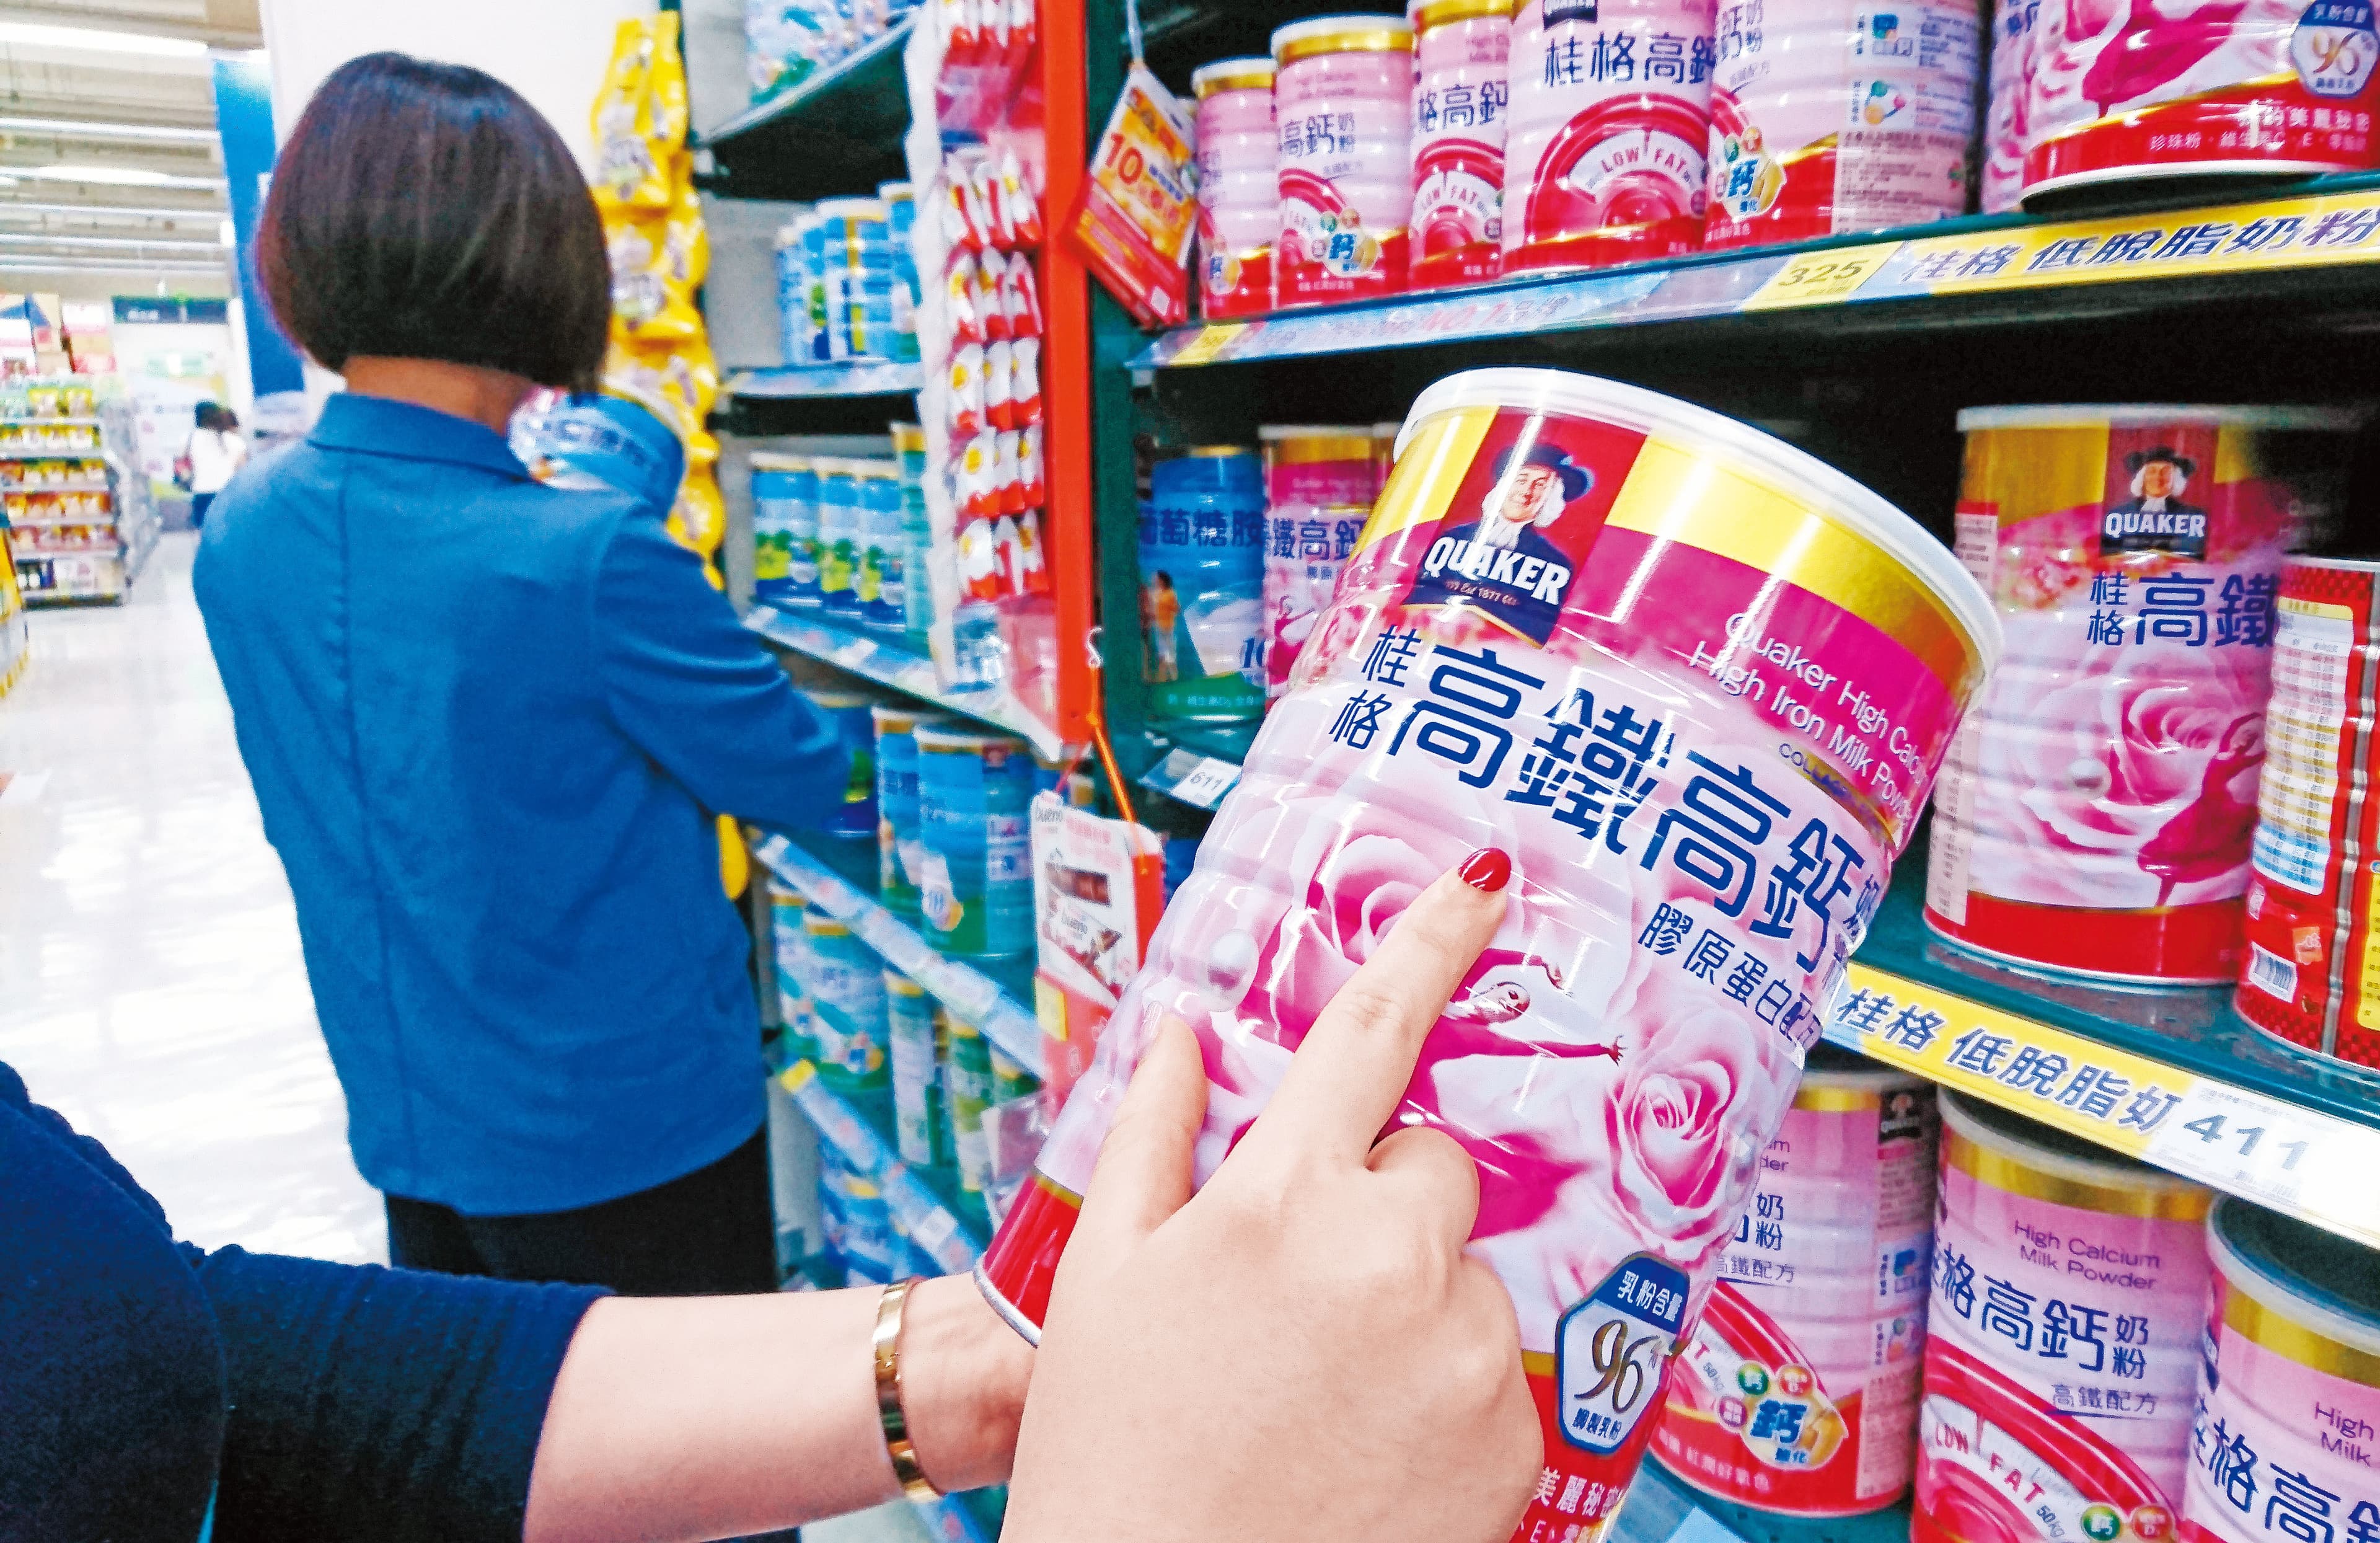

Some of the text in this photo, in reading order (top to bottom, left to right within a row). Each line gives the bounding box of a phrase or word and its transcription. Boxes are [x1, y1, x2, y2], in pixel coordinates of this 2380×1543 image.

[1779, 259, 1869, 286] 325
[1900, 244, 2024, 279] 桂格
[2105, 512, 2205, 537] QUAKER
[1424, 536, 1571, 606] QUAKER
[2086, 571, 2130, 647] 桂格
[1725, 612, 1838, 692] Quaker
[1836, 680, 1889, 739] High
[1688, 640, 1766, 702] High
[1770, 685, 1826, 740] Iron
[1828, 725, 1874, 777] Milk
[1189, 771, 1223, 792] 611
[1329, 624, 1423, 750] 桂格
[1386, 648, 1866, 974] 高鐵高鈣
[1836, 988, 1946, 1051] 桂格
[2183, 1114, 2309, 1171] 411
[2014, 1219, 2160, 1270] High Calcium
[2019, 1244, 2157, 1291] Milk Powder
[1574, 1319, 1660, 1413] 96
[2052, 1382, 2157, 1416] 高鐵配方
[2314, 1401, 2374, 1442] High
[2320, 1431, 2371, 1467] Milk
[1988, 1452, 2045, 1504] FAT
